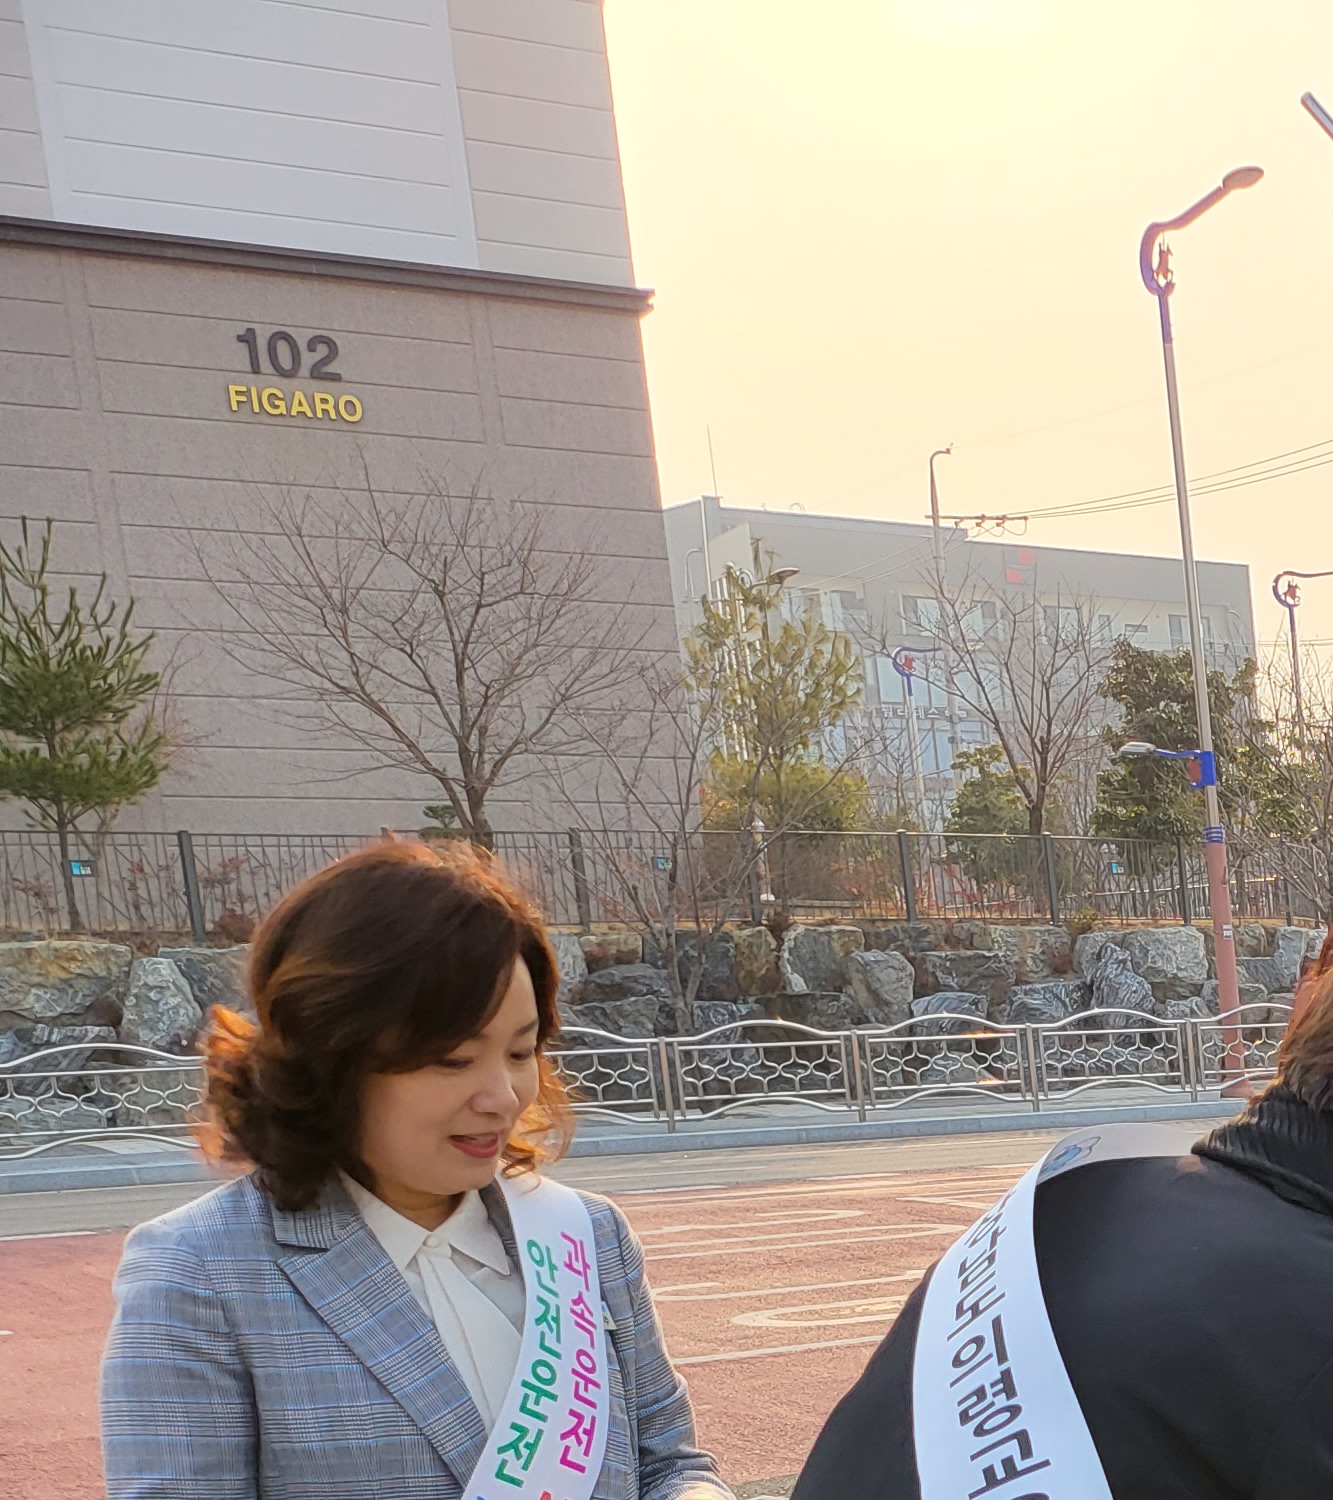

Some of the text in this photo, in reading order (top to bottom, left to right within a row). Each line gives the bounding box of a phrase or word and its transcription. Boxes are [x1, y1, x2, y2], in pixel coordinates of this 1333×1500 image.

[229, 384, 364, 424] FIGARO
[236, 327, 343, 384] 102
[494, 1238, 563, 1489] 안전운전
[558, 1230, 602, 1475] 과속운전
